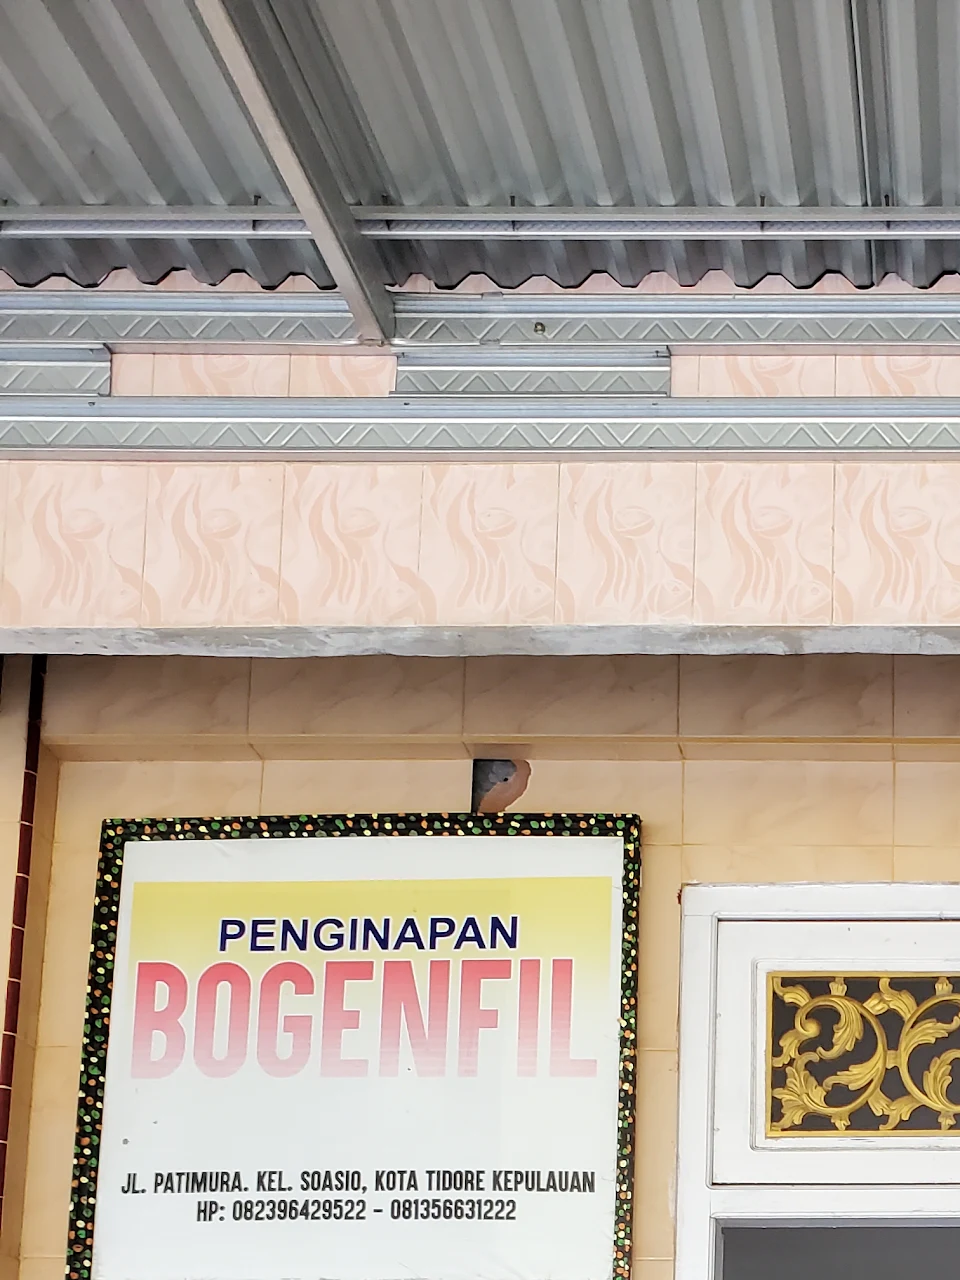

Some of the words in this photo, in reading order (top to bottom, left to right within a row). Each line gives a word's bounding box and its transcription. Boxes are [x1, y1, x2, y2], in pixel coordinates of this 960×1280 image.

[218, 916, 519, 952] PENGINAPAN
[130, 958, 598, 1079] BOGENFIL
[121, 1172, 147, 1194] JL.
[153, 1171, 249, 1194] PATIMURA.
[256, 1170, 293, 1192] KEL.
[300, 1170, 368, 1194] SOASIO,
[374, 1170, 419, 1192] KOTA
[425, 1170, 486, 1192] TIDORE
[492, 1170, 595, 1193] KEPULAUAN
[196, 1200, 226, 1222] HP:
[232, 1199, 366, 1221] 082396429522
[390, 1198, 516, 1221] 081356631222
